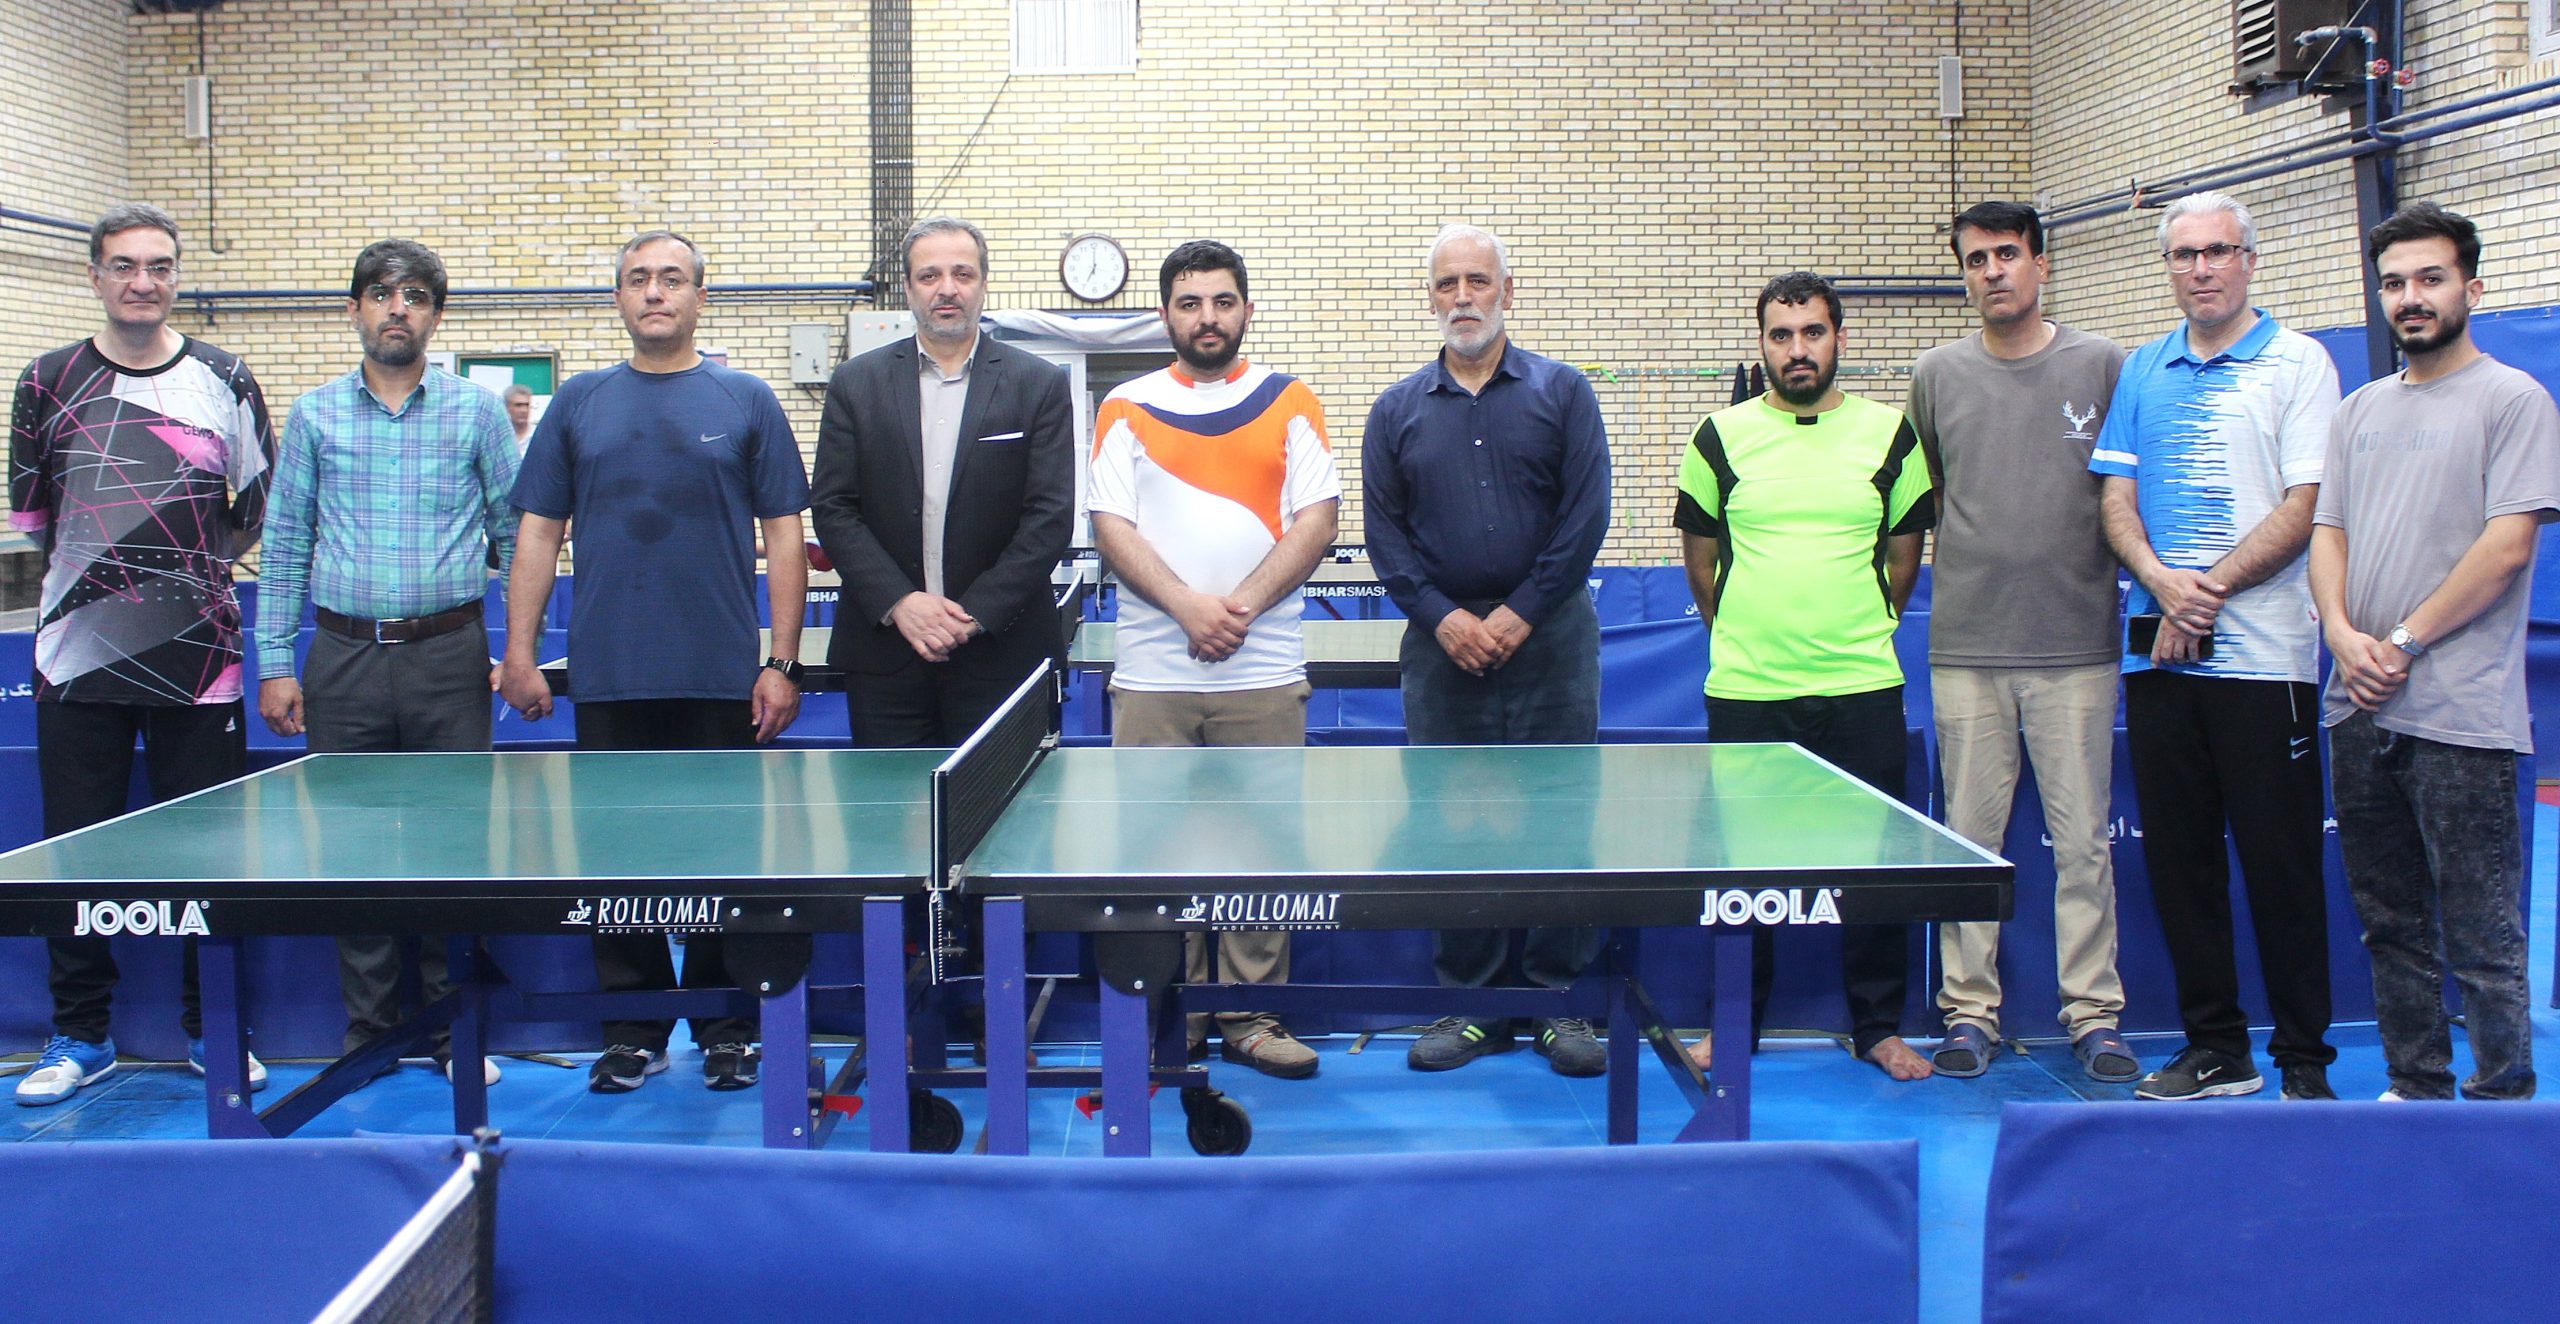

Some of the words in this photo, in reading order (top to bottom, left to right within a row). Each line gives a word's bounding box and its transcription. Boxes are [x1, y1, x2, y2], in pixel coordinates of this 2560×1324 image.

[806, 591, 839, 603] IBHA
[597, 896, 724, 924] ROLLOMAT
[1211, 893, 1341, 922] ROLLOMAT
[1211, 924, 1245, 932] MADE
[1278, 924, 1341, 932] GERMANY
